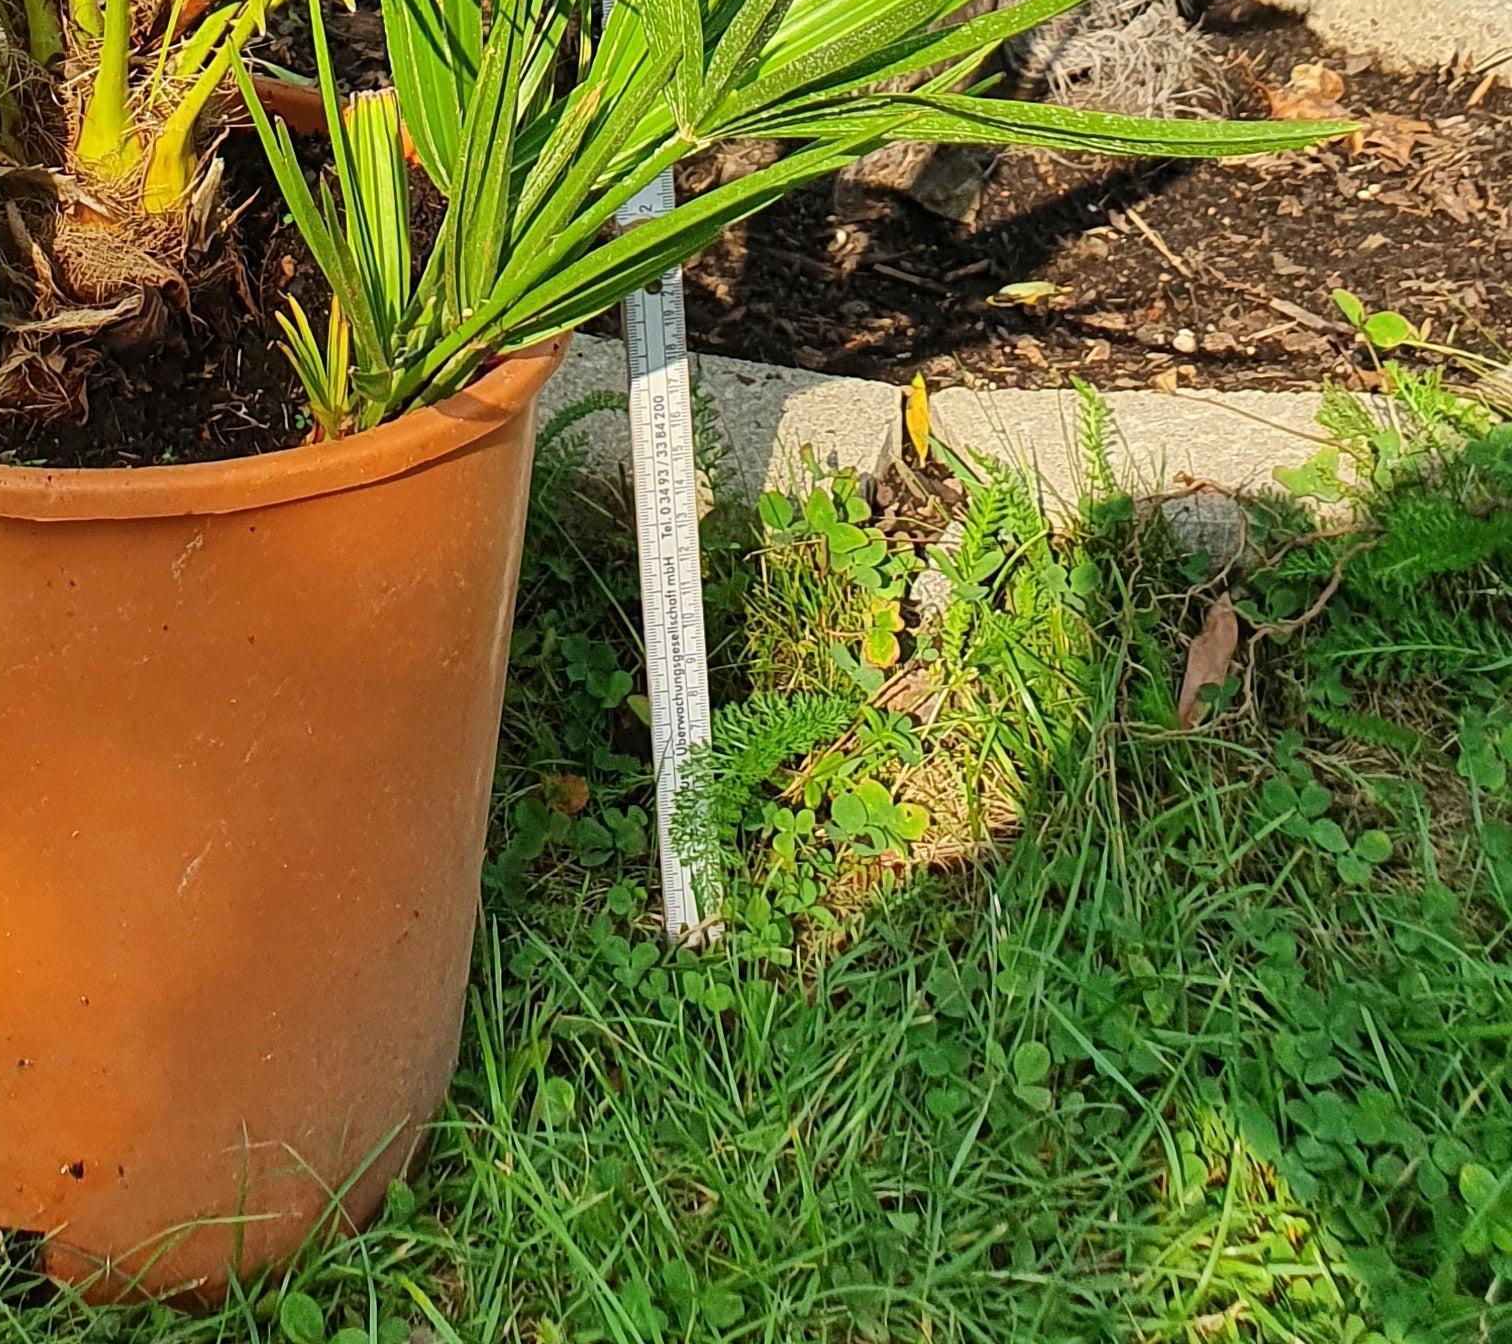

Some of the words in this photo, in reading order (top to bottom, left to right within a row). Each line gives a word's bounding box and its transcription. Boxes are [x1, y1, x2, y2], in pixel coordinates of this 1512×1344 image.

[664, 310, 675, 326] 19
[666, 344, 676, 360] 18
[668, 378, 679, 394] 17
[671, 411, 682, 432] 16
[672, 445, 683, 464] 15
[674, 479, 685, 497] 14
[660, 518, 673, 539] Tel.
[677, 512, 688, 529] 13
[679, 545, 690, 563] 12
[665, 555, 676, 586] mbH
[680, 579, 692, 596] 11
[682, 612, 694, 628] 10
[686, 656, 697, 665] 9
[688, 689, 699, 698] 8
[691, 719, 701, 730] 7
